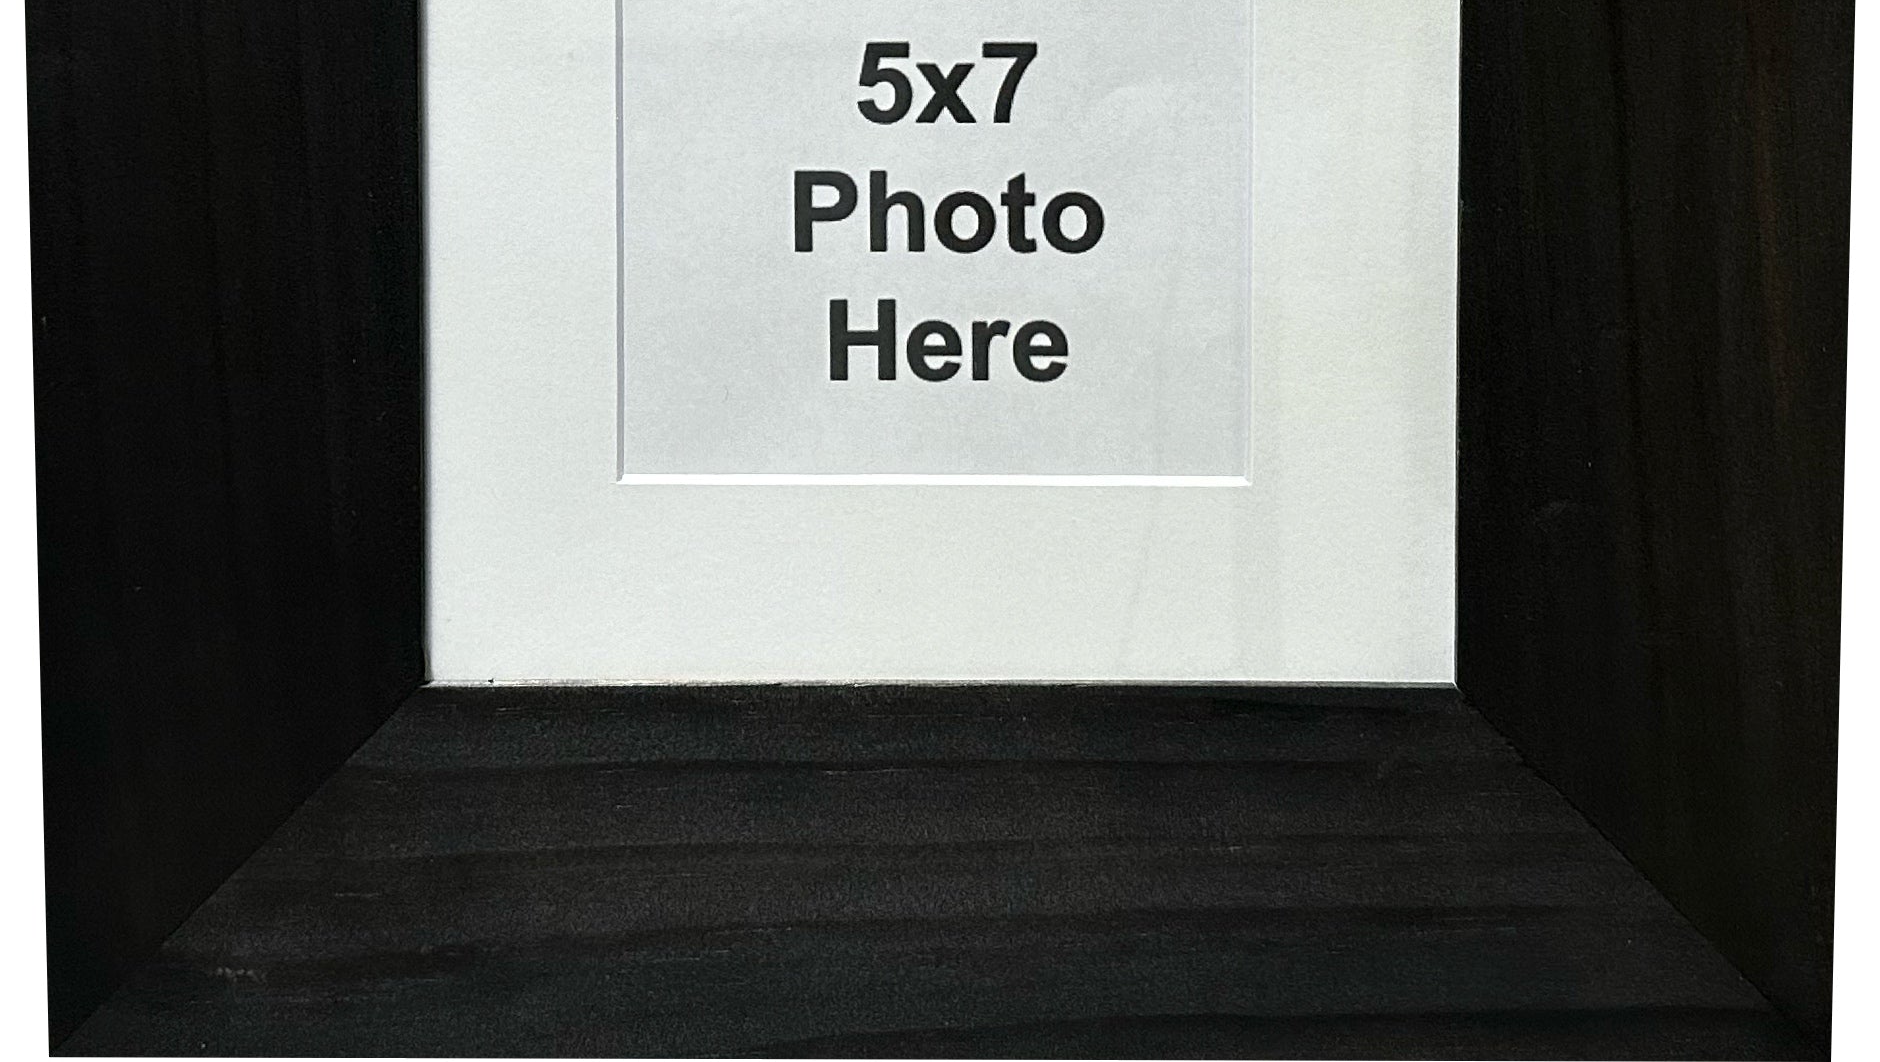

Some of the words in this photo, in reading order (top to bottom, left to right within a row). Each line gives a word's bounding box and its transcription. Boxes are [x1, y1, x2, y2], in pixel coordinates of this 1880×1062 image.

[857, 41, 1038, 125] 5x7
[794, 170, 1105, 254] Photo
[829, 298, 1069, 383] Here
